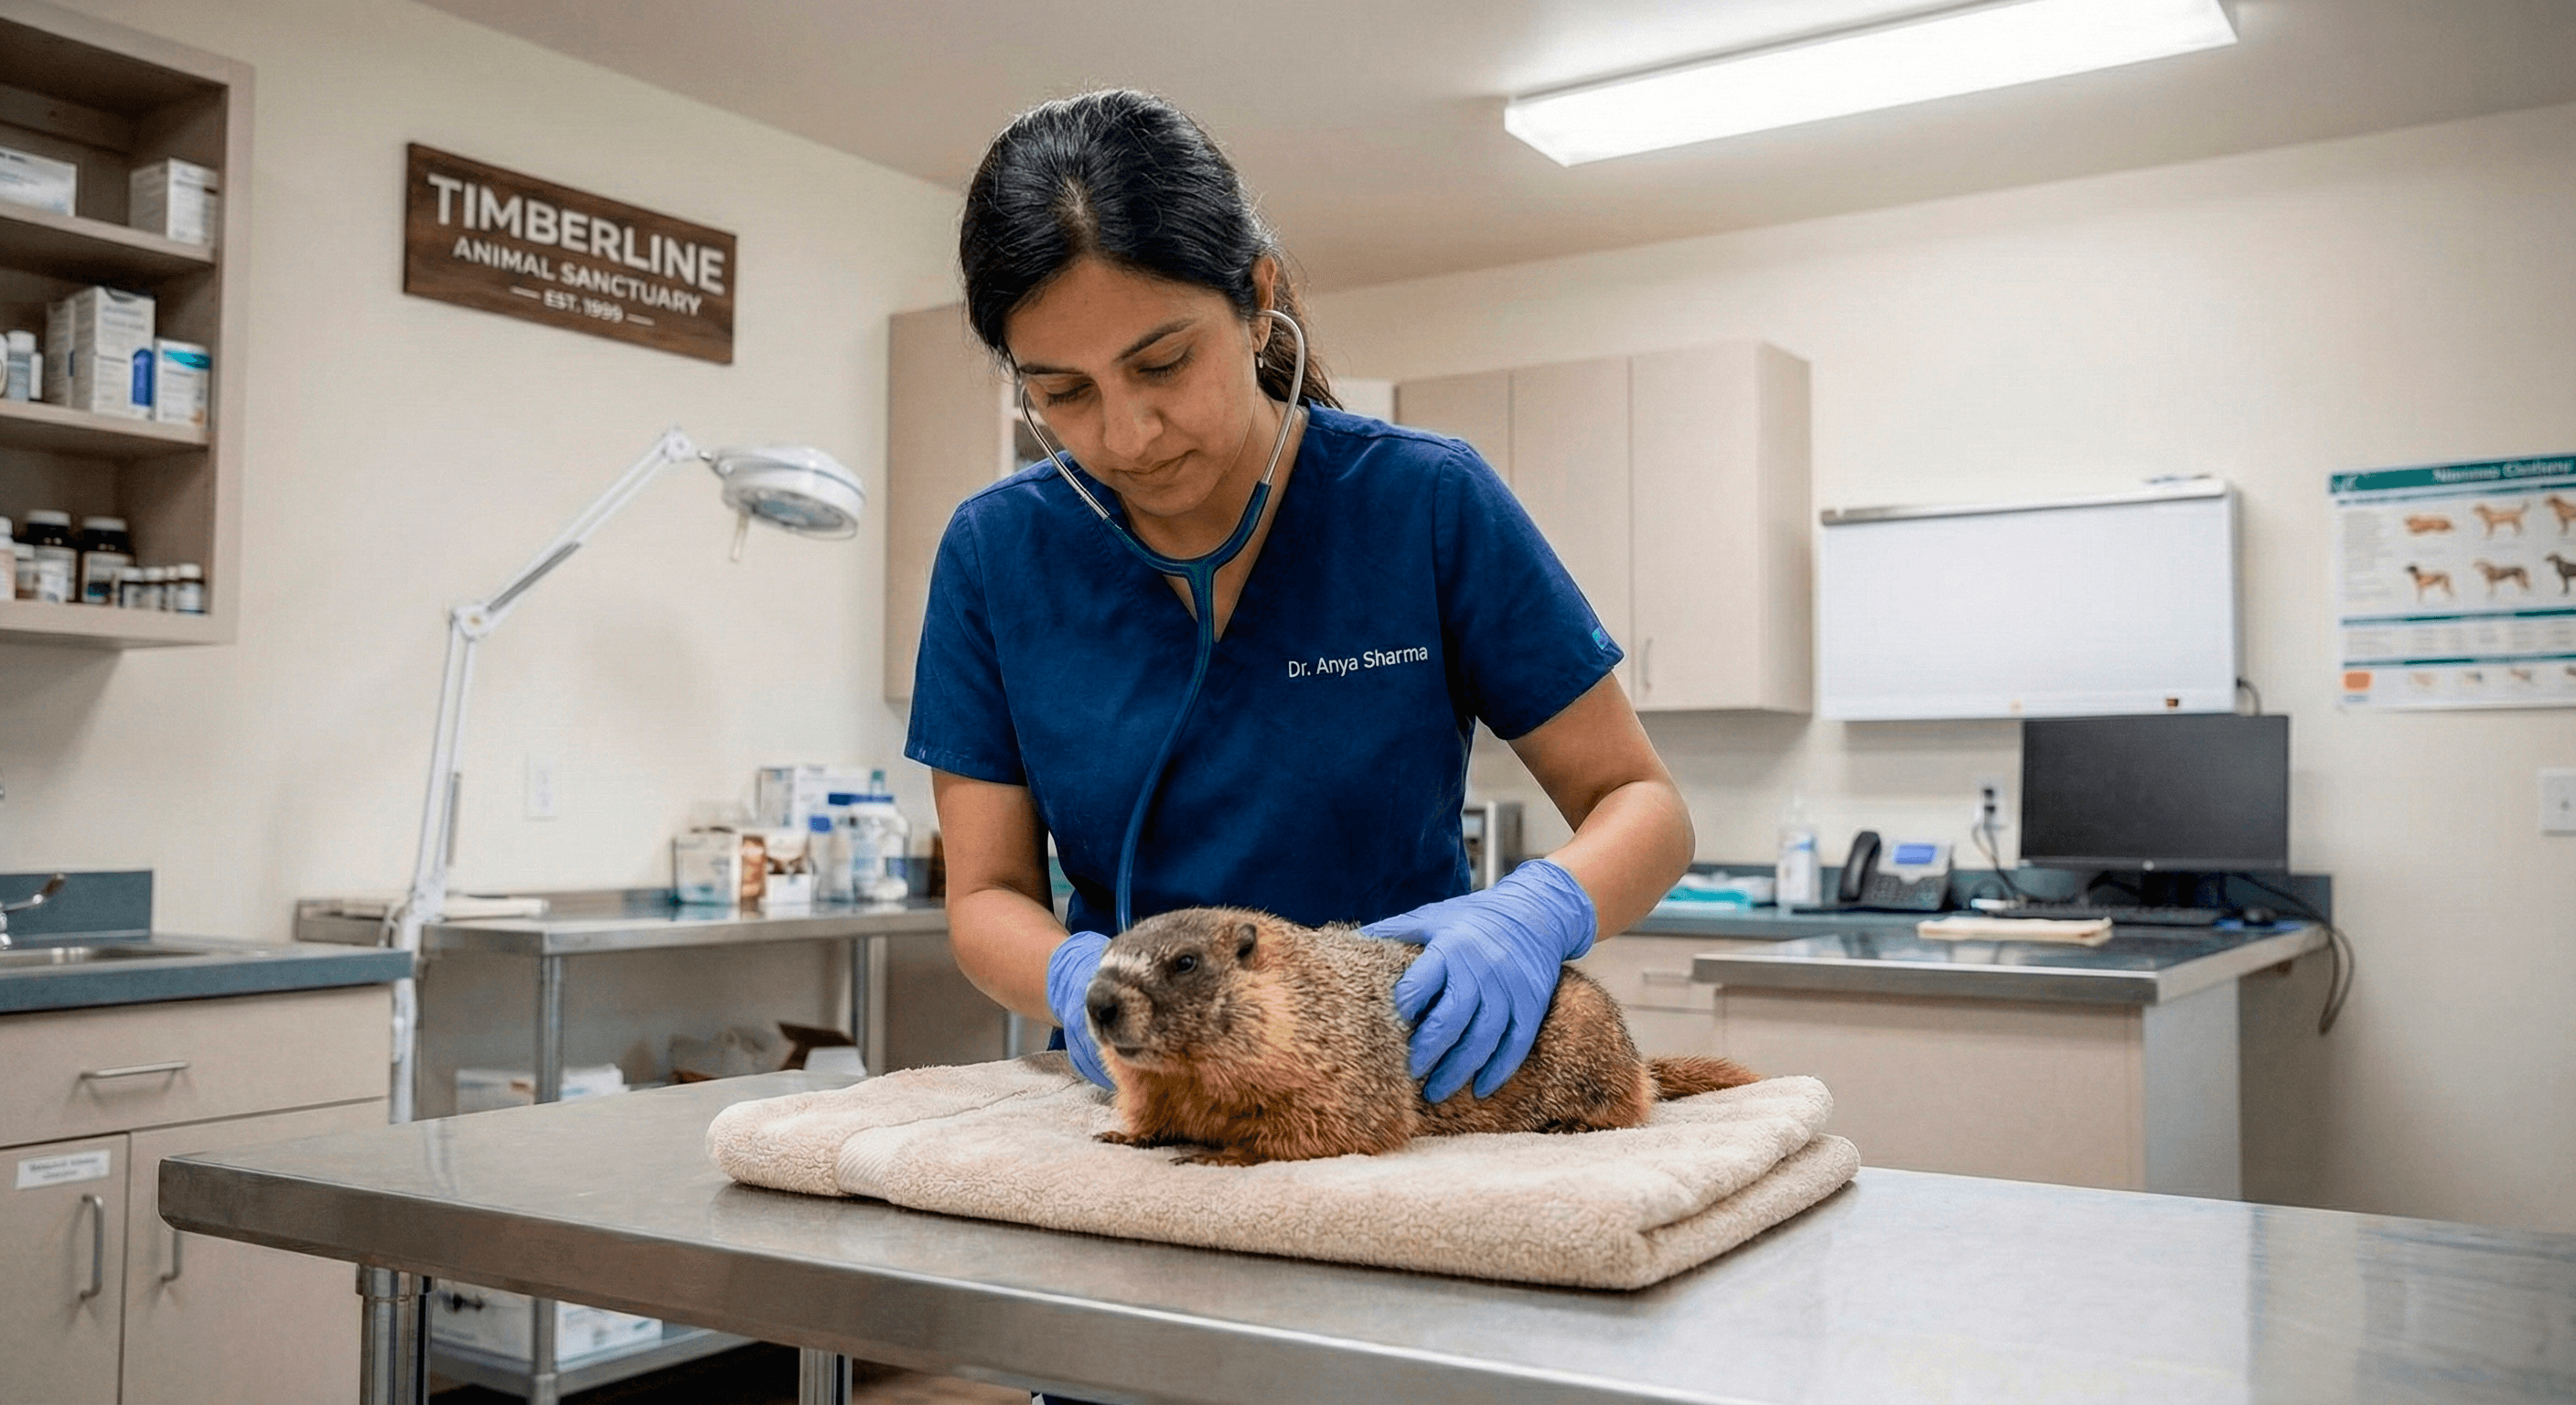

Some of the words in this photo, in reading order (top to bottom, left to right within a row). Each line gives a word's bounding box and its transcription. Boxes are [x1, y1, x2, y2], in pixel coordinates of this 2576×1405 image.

[428, 173, 725, 295] TIMBERLINE
[453, 236, 555, 280] ANIMAL
[560, 263, 702, 316] SANCTUARY
[543, 290, 581, 312] EST.
[584, 297, 623, 323] 1999
[1289, 661, 1311, 678] Dr.
[1316, 657, 1358, 677] Anya
[1363, 647, 1428, 669] Sharma
